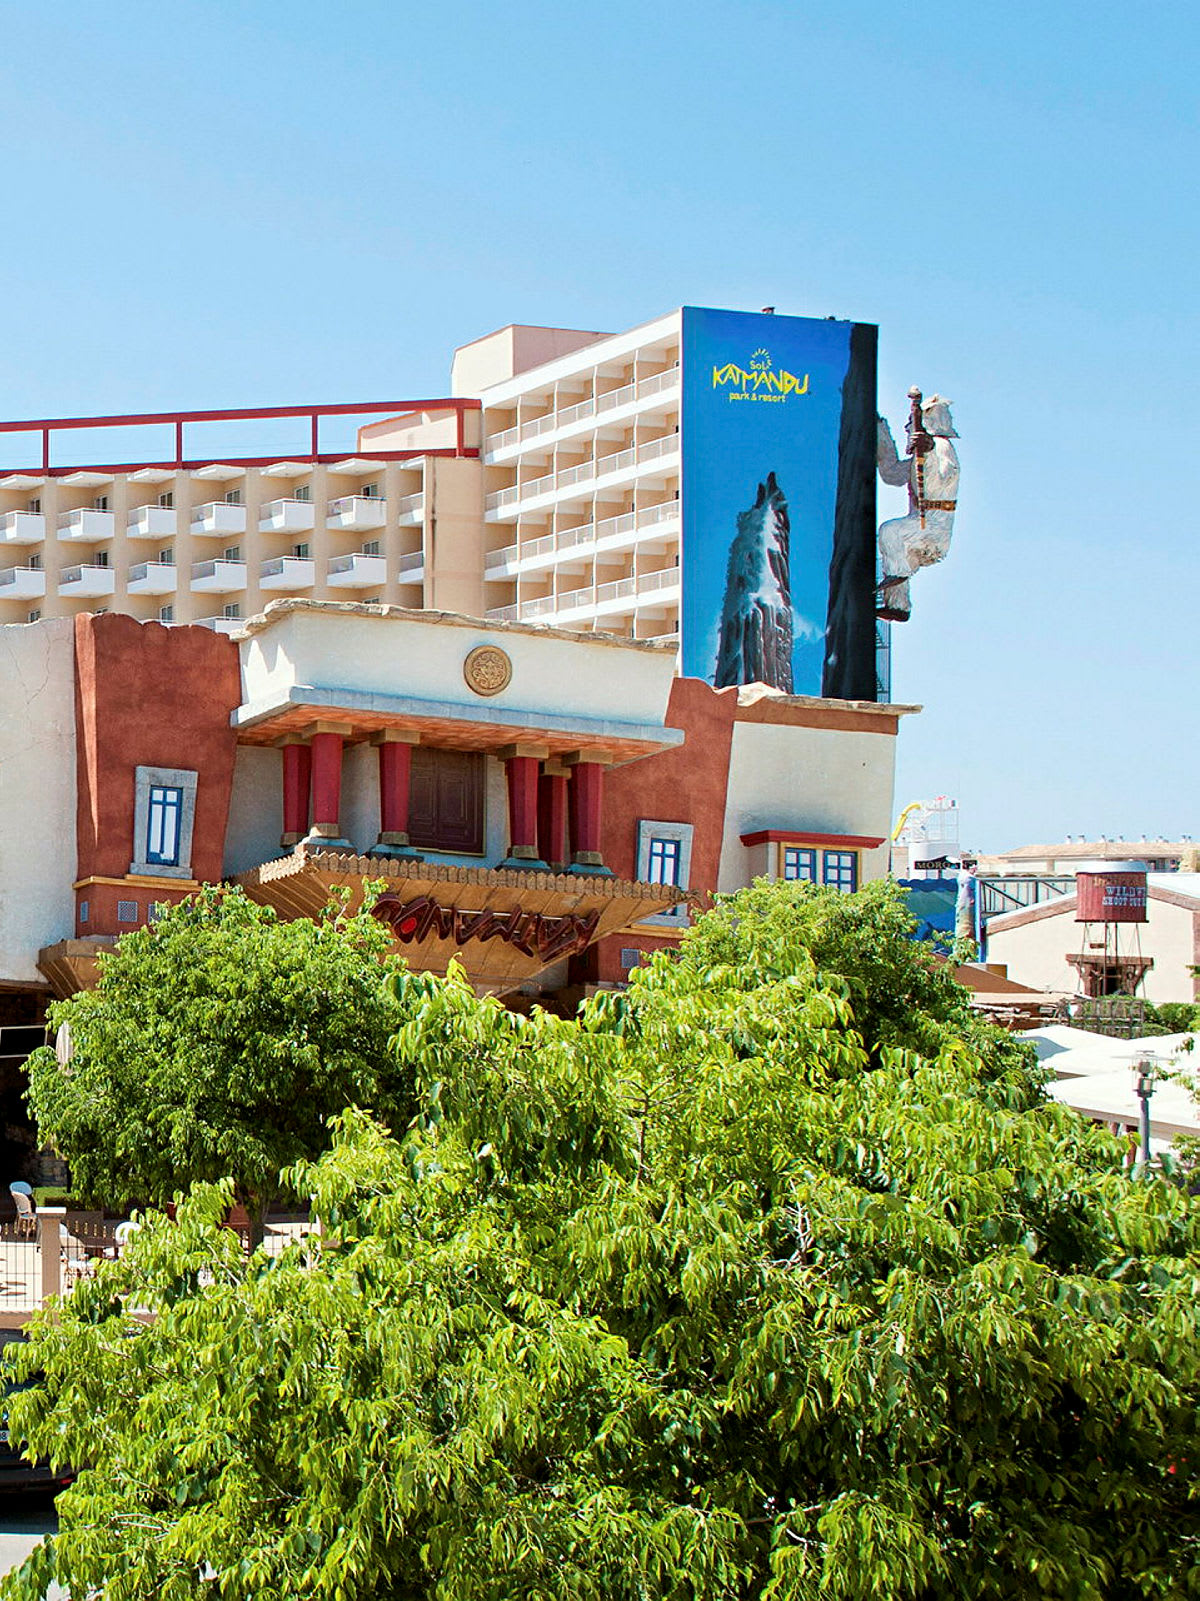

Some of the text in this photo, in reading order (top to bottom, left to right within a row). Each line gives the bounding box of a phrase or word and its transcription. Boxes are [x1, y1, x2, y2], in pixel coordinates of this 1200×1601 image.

[713, 363, 810, 395] KATMANDU
[729, 392, 749, 403] park
[759, 394, 786, 403] resort
